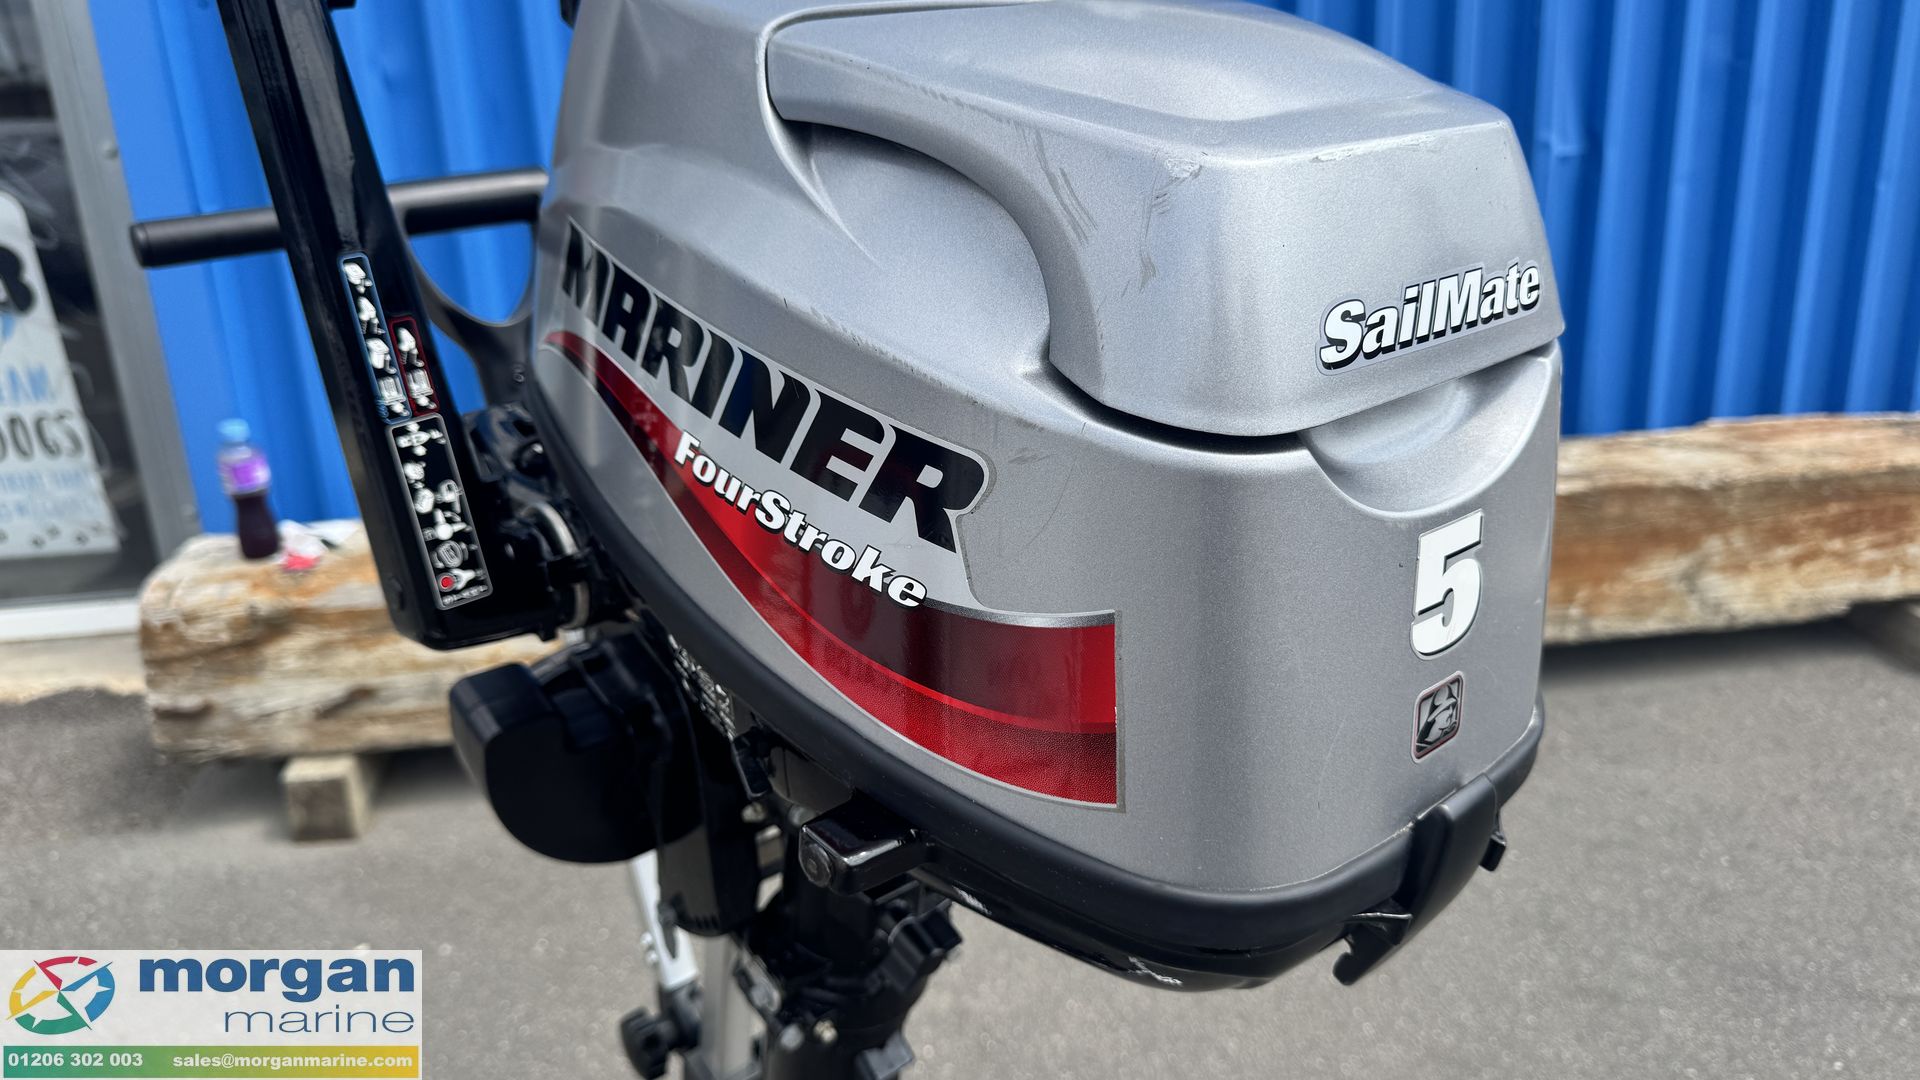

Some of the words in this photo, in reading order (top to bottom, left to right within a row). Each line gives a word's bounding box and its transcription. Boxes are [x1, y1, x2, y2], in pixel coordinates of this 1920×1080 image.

[562, 222, 987, 553] MARINER
[1319, 261, 1540, 370] SailMate
[0, 411, 83, 460] OGS
[674, 429, 928, 609] FourStroke
[1411, 510, 1483, 657] 5
